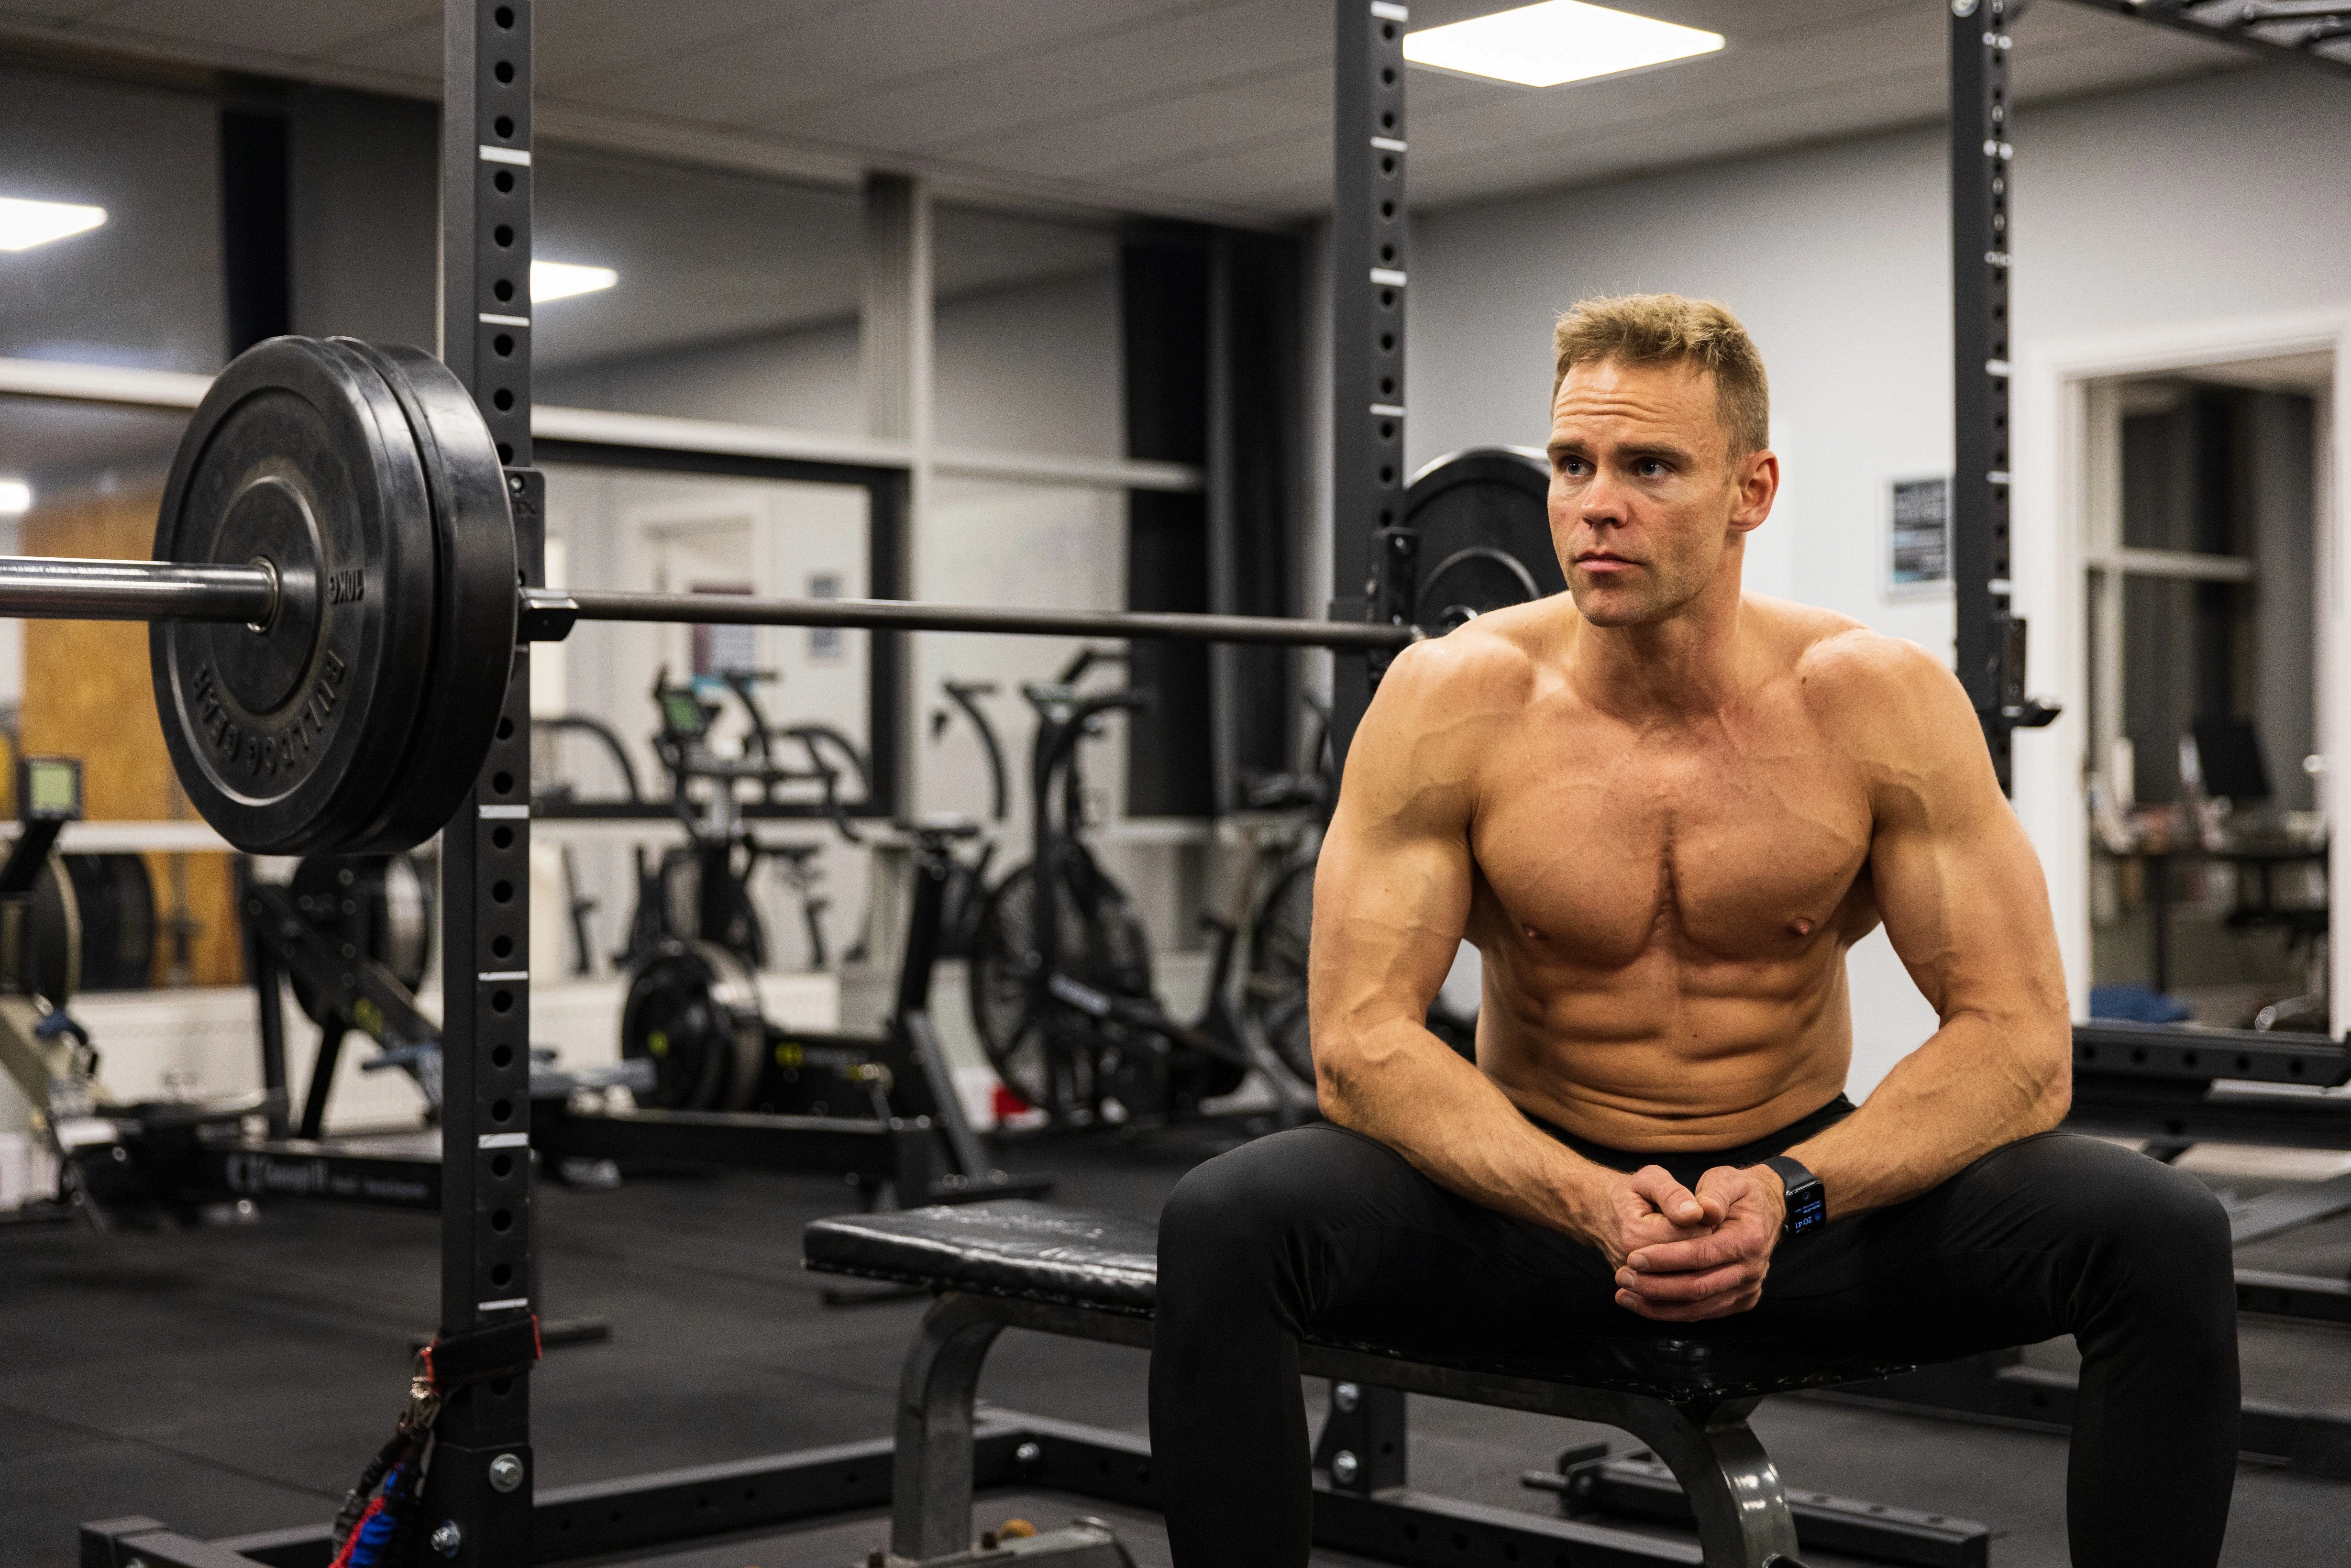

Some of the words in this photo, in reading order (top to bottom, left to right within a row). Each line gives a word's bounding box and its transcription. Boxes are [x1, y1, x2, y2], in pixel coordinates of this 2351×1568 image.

[193, 662, 240, 764] GEAR
[246, 649, 346, 776] BULLDOG
[1795, 1216, 1812, 1228] 20:41
